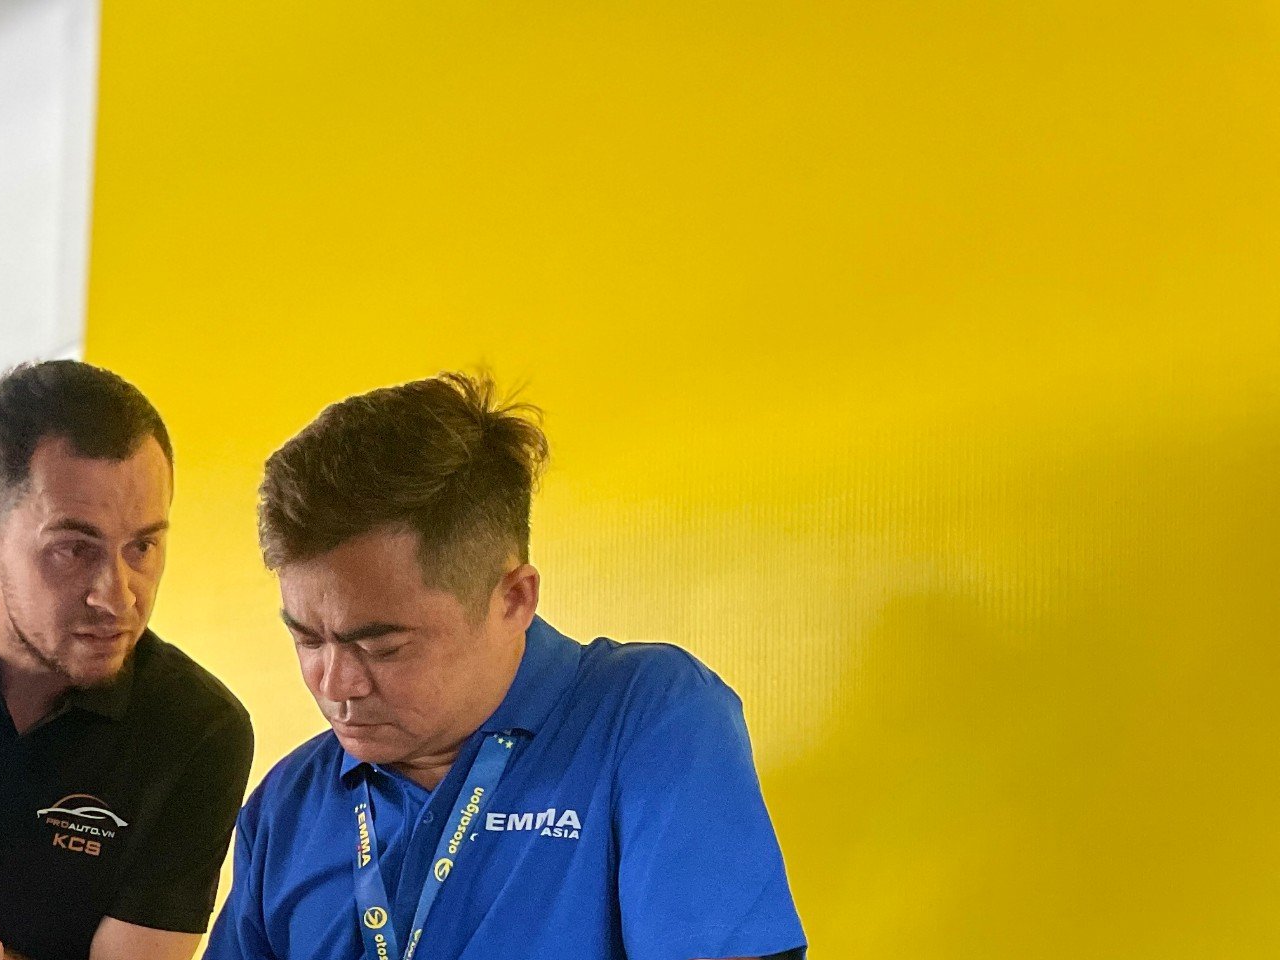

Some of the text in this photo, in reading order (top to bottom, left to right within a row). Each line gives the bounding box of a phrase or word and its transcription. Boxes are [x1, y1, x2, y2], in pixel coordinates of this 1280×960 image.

[358, 811, 371, 867] EMMA
[448, 787, 484, 854] otosaigon
[540, 827, 579, 839] ASIA
[52, 832, 101, 856] KCS
